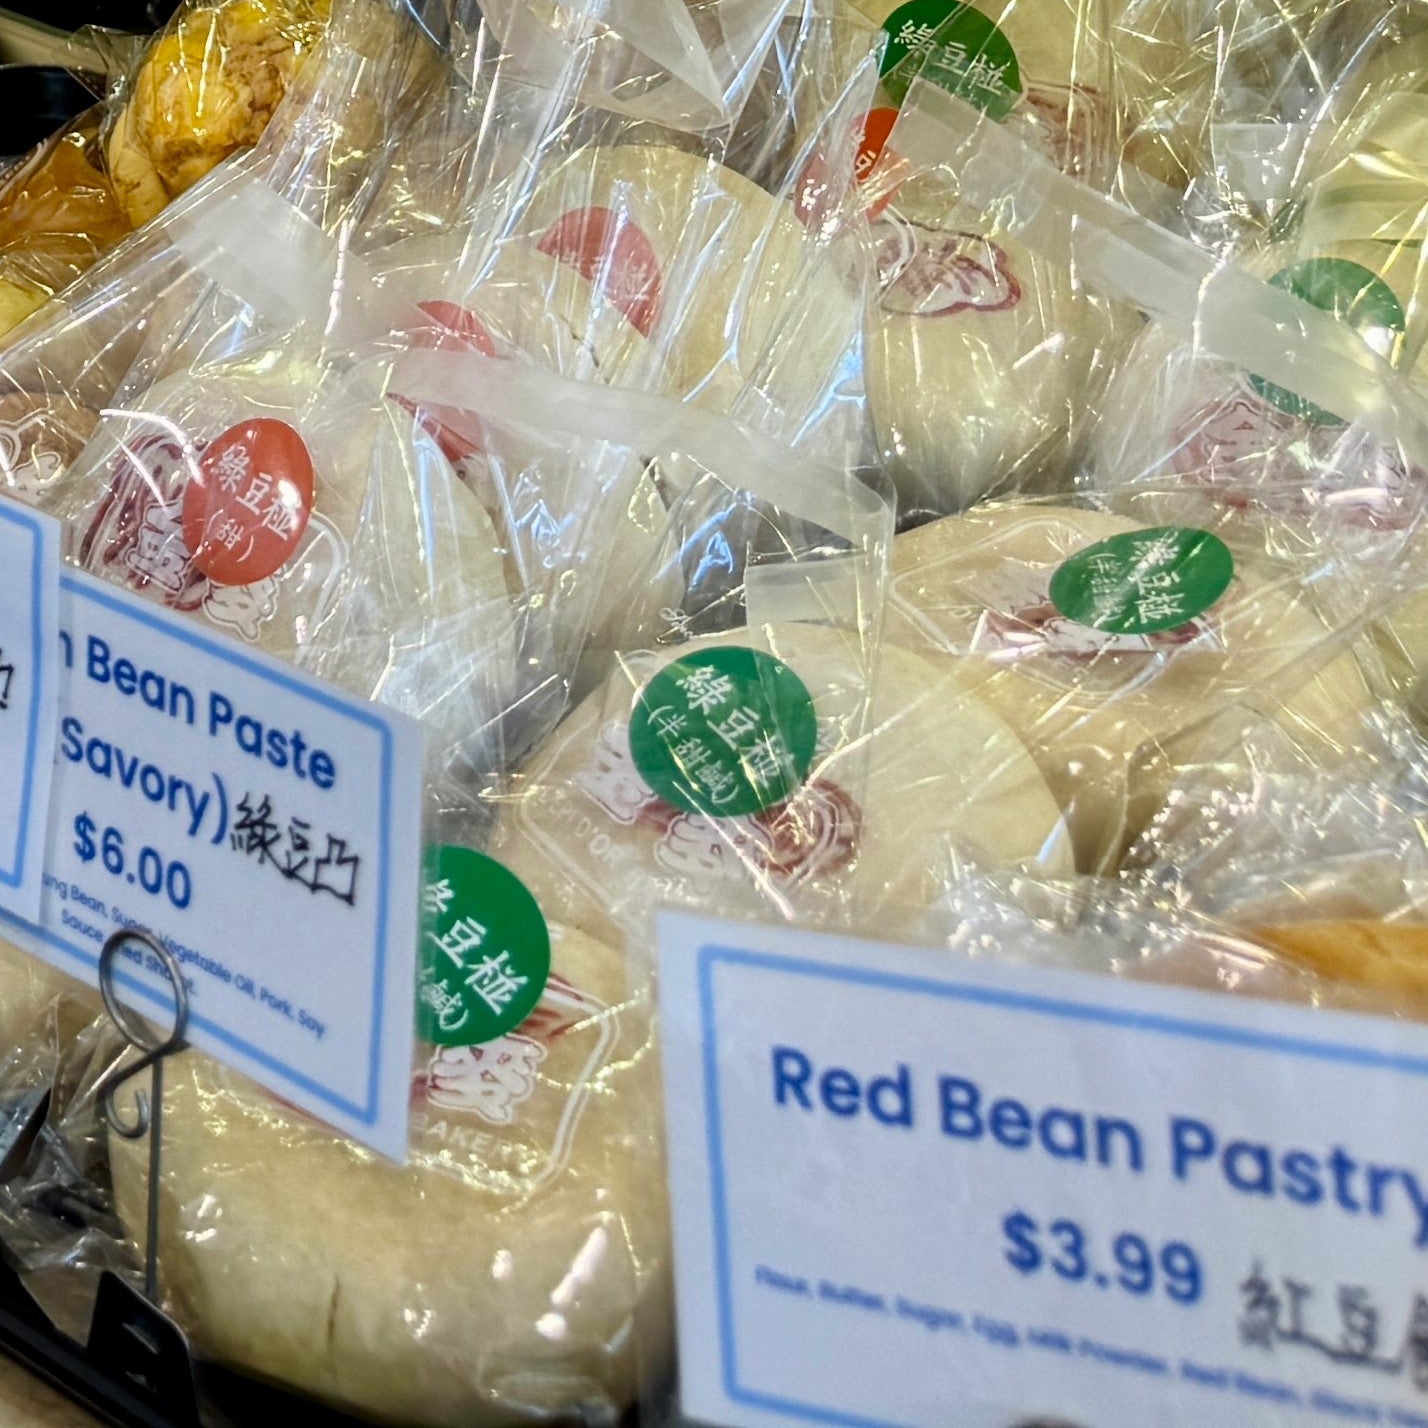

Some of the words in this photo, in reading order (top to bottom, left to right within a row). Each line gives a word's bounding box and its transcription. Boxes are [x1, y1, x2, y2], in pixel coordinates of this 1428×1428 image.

[86, 633, 196, 728] Bean
[207, 690, 338, 794] Paste
[60, 714, 231, 846] Savory)
[72, 810, 193, 912] $6.00
[296, 1008, 326, 1041] Soy
[771, 1044, 916, 1131] Red
[938, 1072, 1147, 1174] Bean
[1168, 1113, 1428, 1248] Pastry
[1000, 1208, 1204, 1308] $3.99
